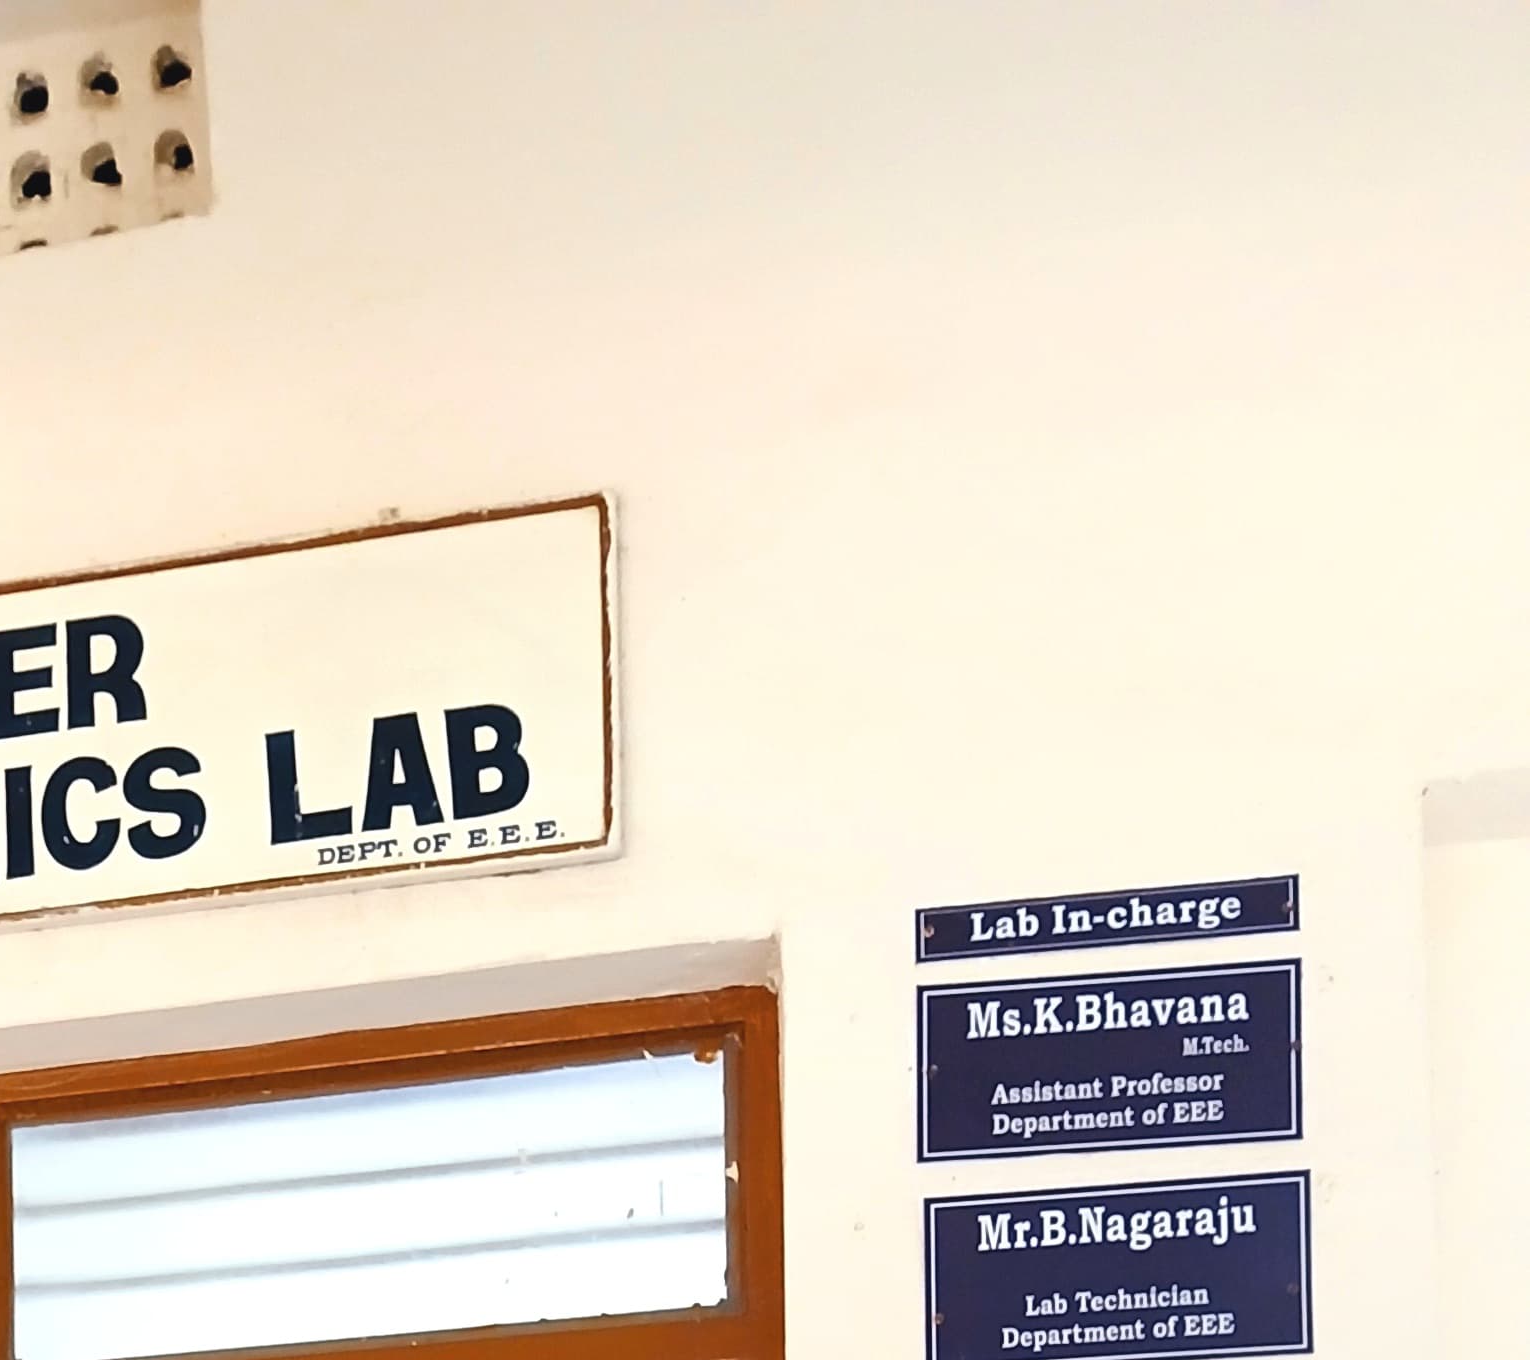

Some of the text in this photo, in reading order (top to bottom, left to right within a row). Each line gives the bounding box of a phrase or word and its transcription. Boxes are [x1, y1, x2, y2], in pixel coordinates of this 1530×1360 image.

[266, 702, 532, 846] LAB
[317, 820, 566, 865] DEPT. OF E.E.E.
[970, 896, 1242, 942] Lab In-charge
[966, 991, 1250, 1039] Ms.K.Bhavana
[1182, 1034, 1250, 1056] M.Tech.
[991, 1072, 1225, 1105] Assistant Professor
[992, 1099, 1225, 1139] Department of EEE
[977, 1195, 1257, 1251] Mr.B.Nagaraju
[1025, 1284, 1210, 1317] Lab Technician
[1001, 1312, 1235, 1352] Department of EEE
